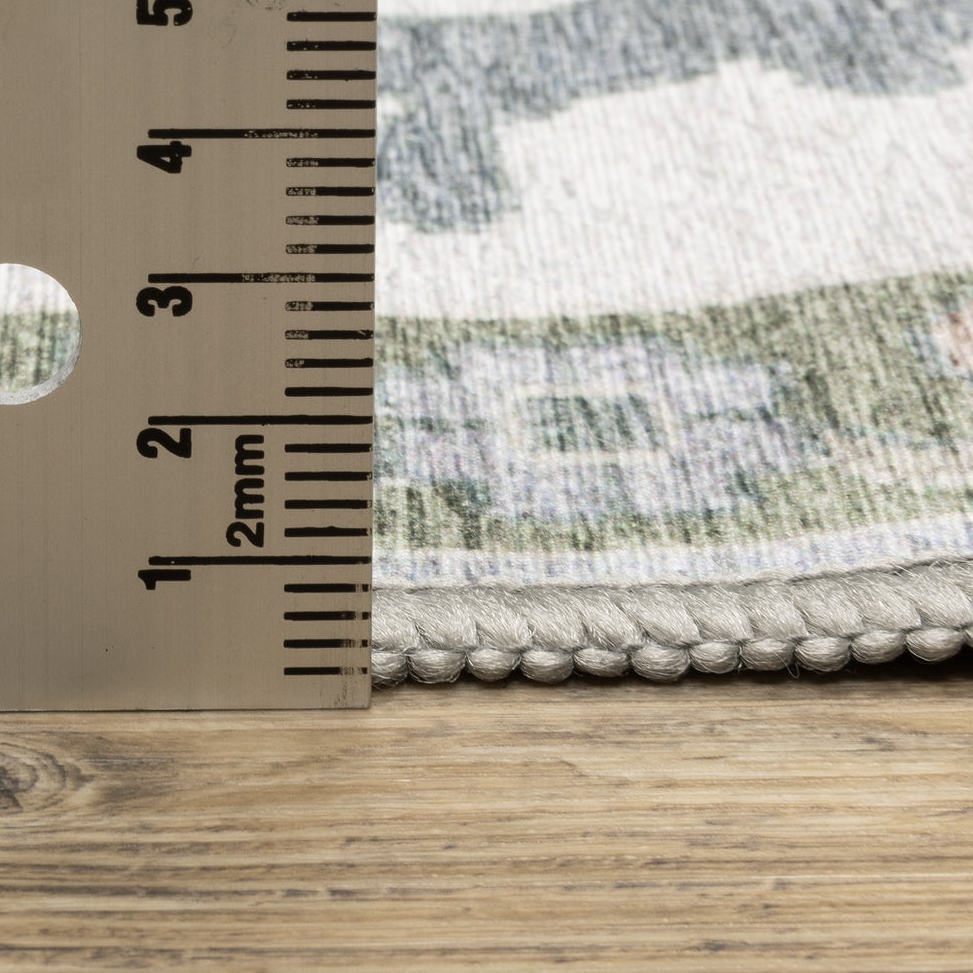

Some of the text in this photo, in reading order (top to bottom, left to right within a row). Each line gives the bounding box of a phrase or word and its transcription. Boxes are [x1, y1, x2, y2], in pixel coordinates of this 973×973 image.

[136, 140, 192, 174] 4
[135, 285, 193, 317] 3
[136, 427, 192, 459] 2
[225, 434, 265, 548] 2mm
[137, 568, 192, 591] 1
